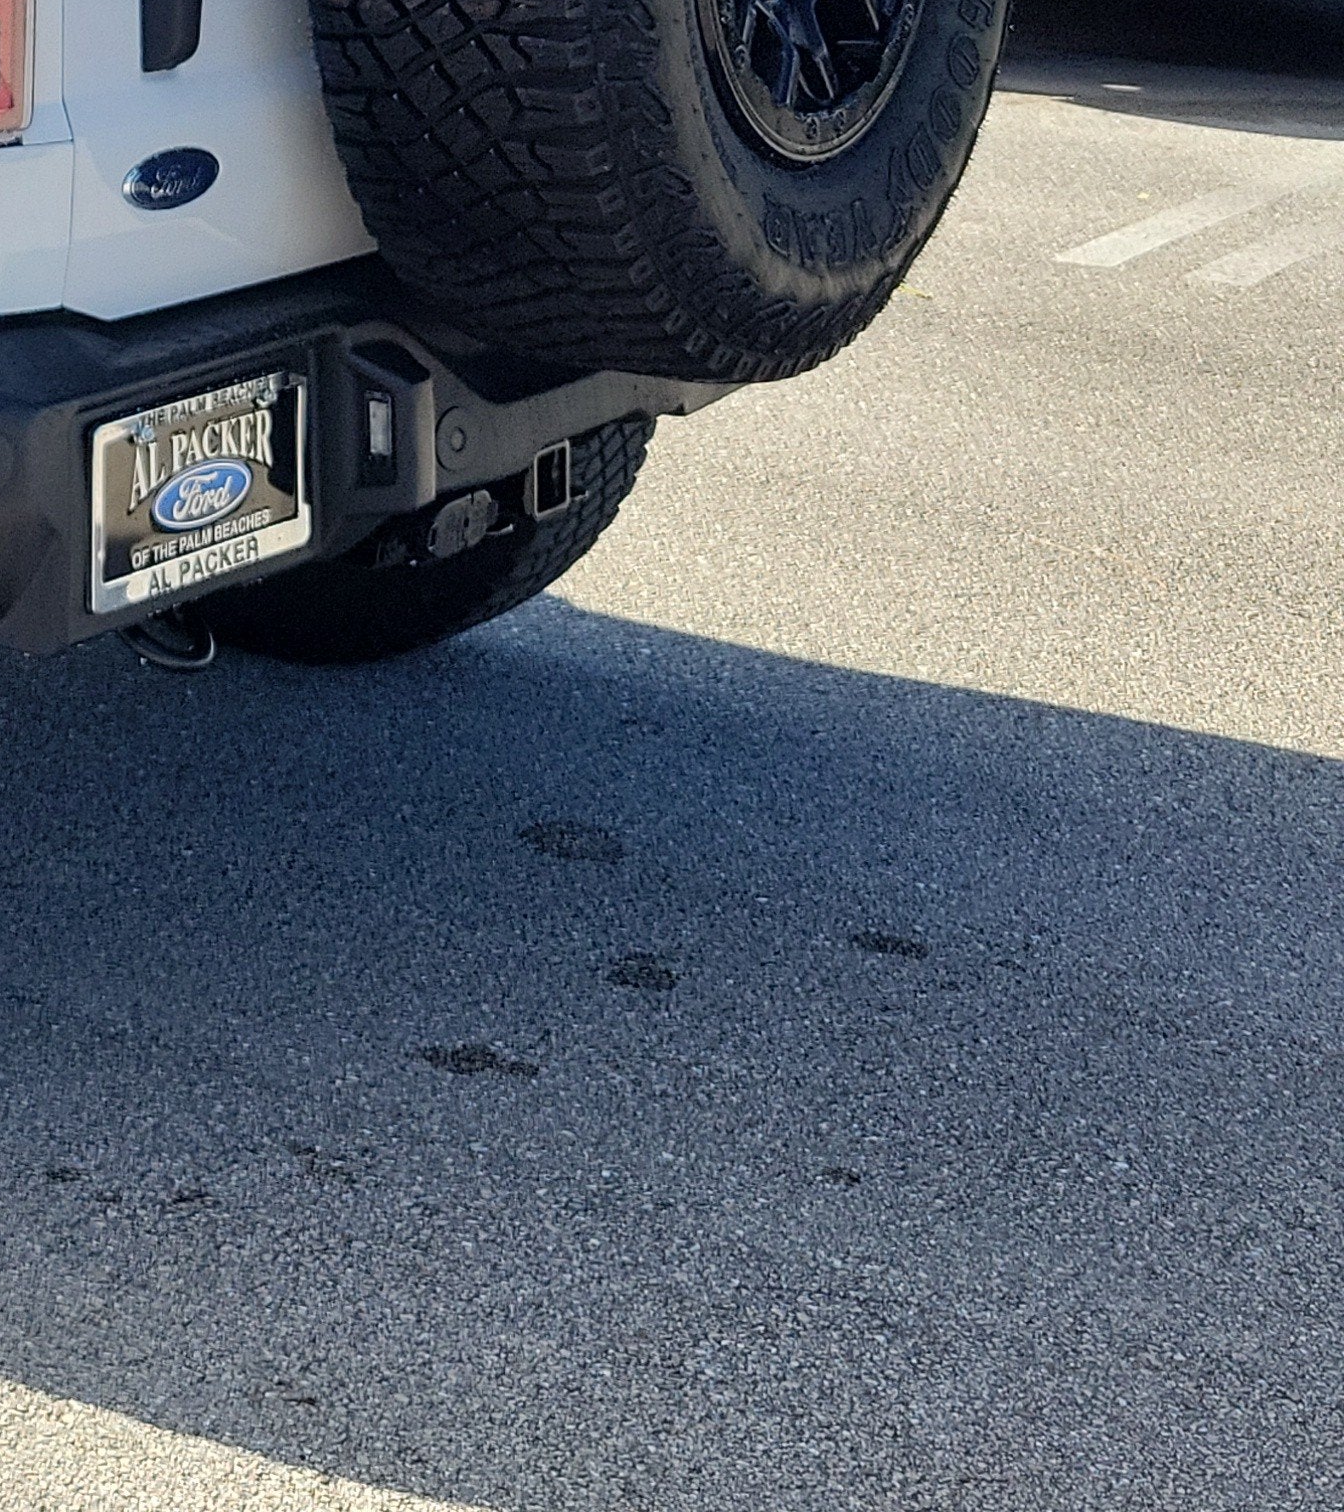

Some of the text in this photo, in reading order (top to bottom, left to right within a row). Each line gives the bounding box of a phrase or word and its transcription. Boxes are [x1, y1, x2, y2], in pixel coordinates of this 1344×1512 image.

[169, 396, 207, 423] PALM
[129, 409, 274, 513] AL PACKER
[172, 471, 234, 521] Ford
[131, 508, 272, 570] OF THE PALM BEACHES
[148, 535, 260, 595] AL PACKER
